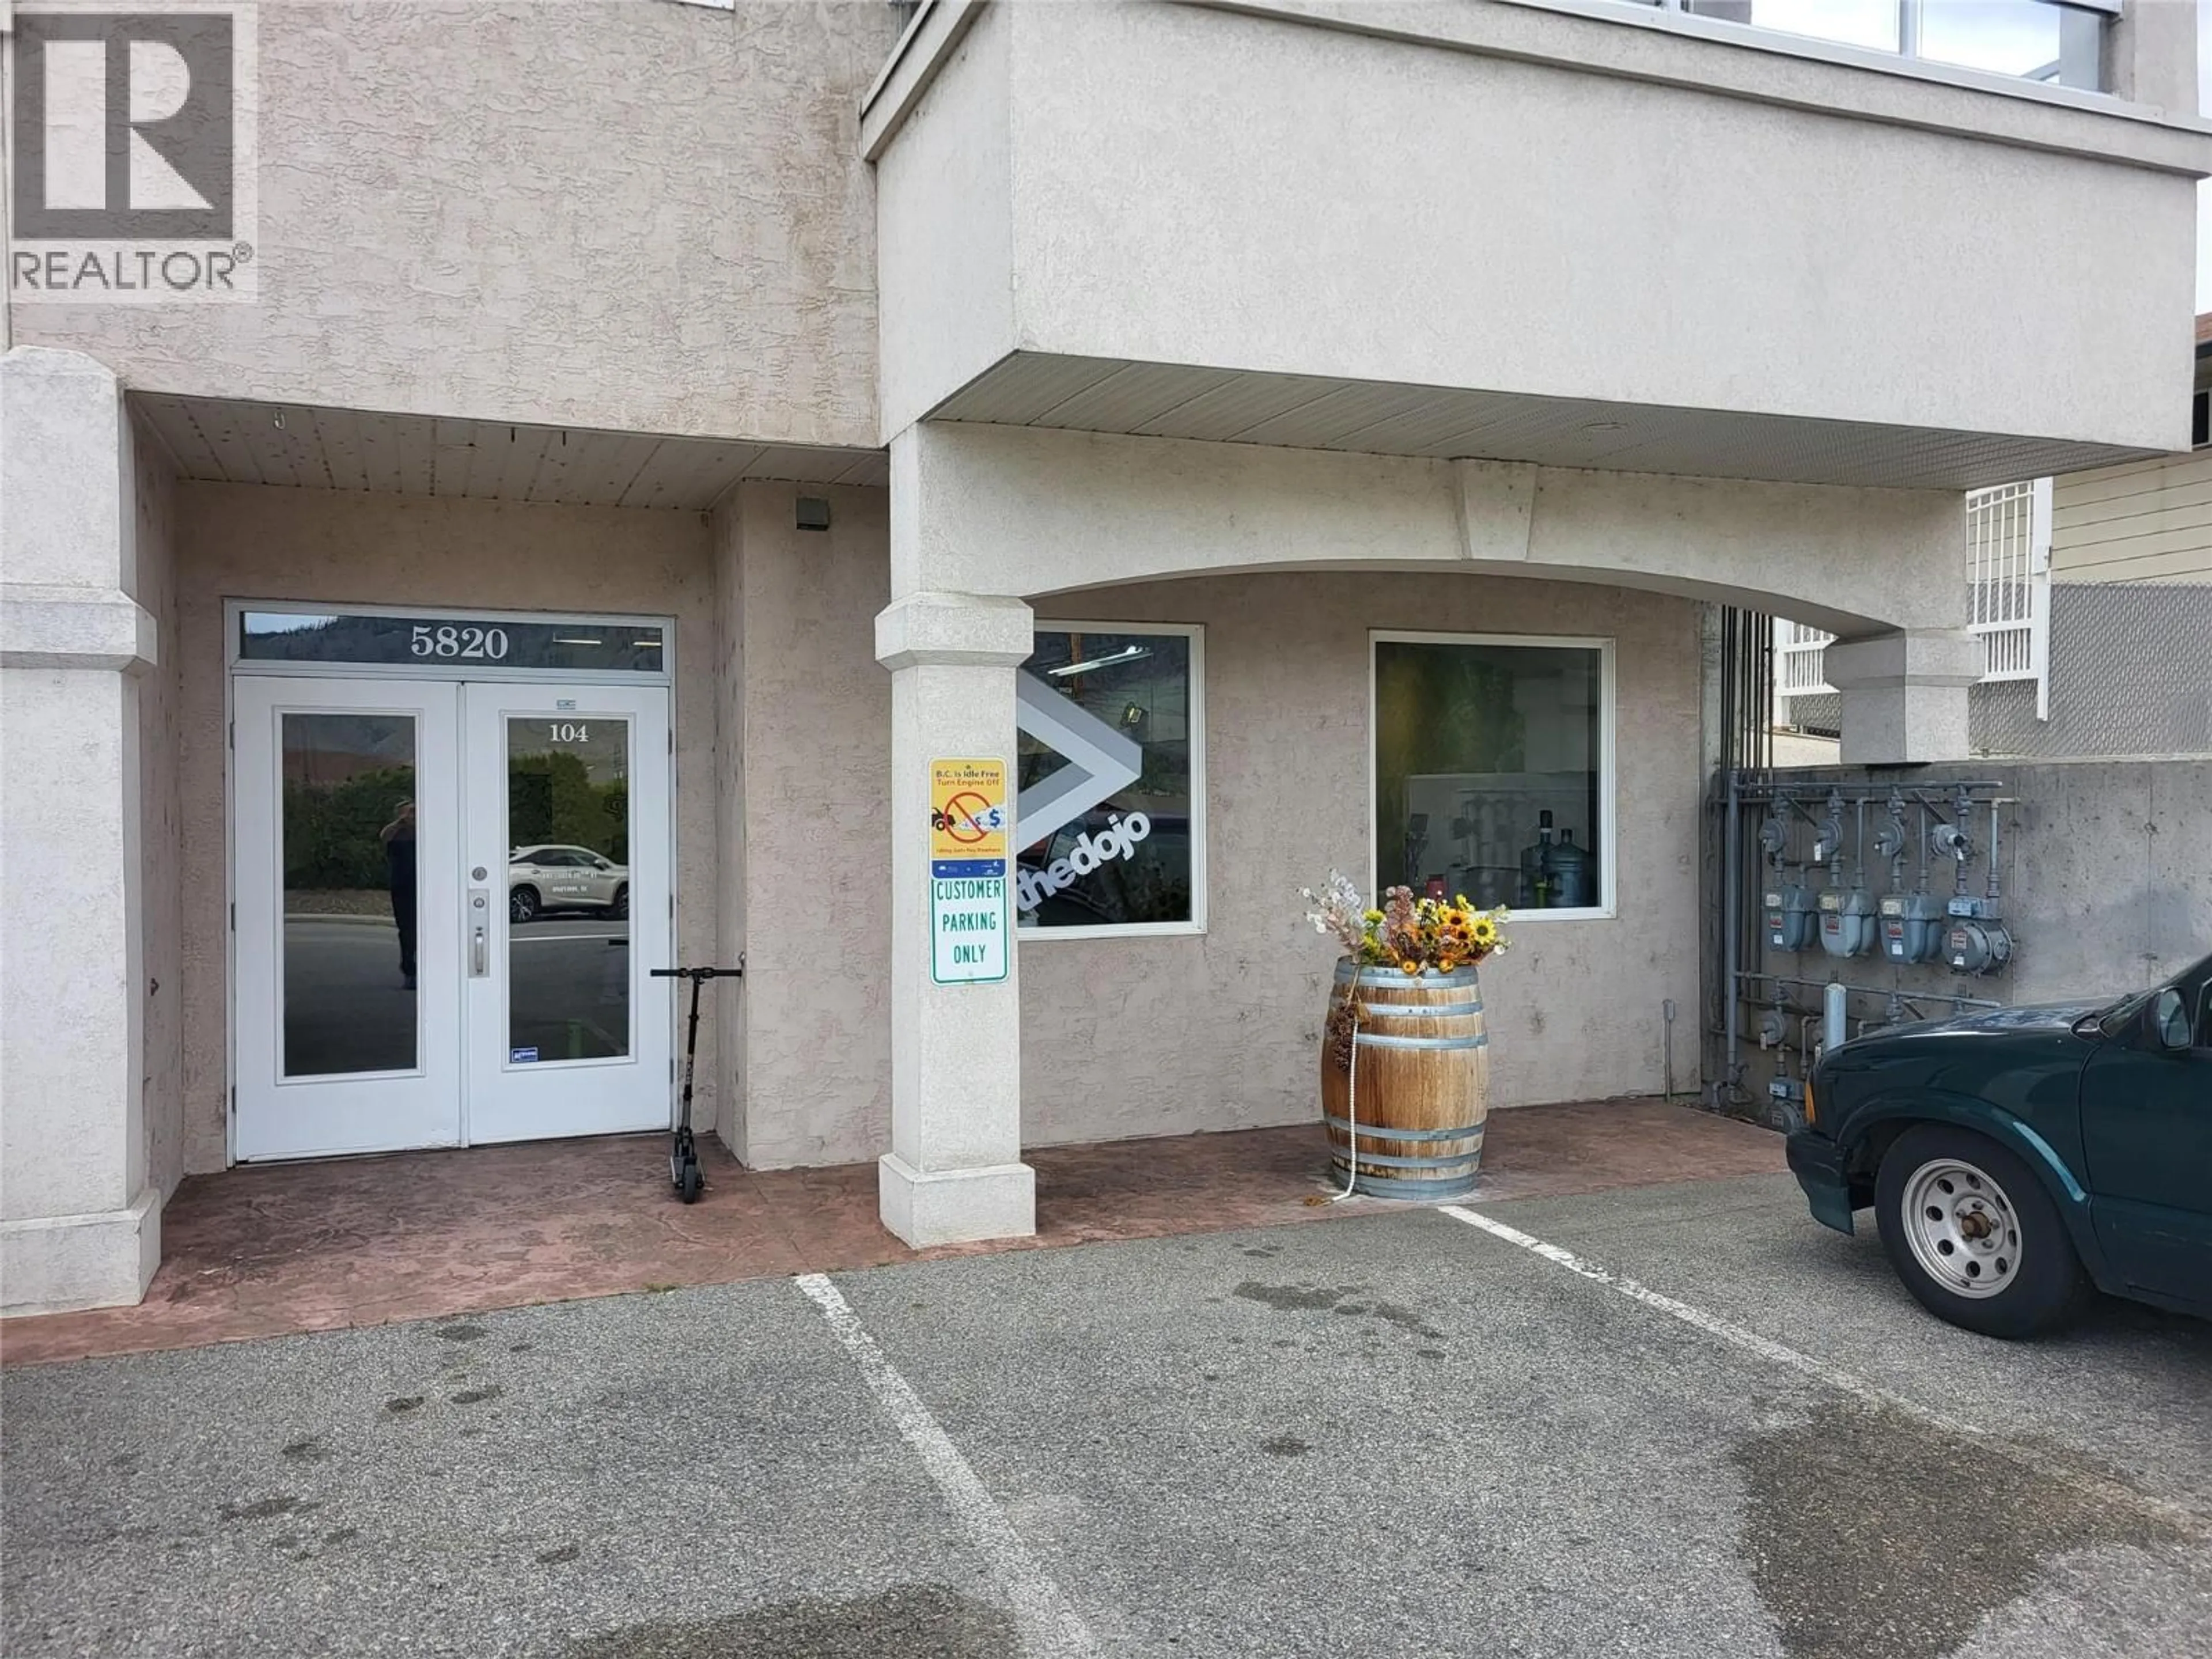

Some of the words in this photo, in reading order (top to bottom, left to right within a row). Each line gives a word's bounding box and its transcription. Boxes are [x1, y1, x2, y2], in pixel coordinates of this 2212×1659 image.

[411, 626, 509, 659] 5820
[550, 723, 589, 743] 104
[957, 779, 984, 787] Engine
[937, 880, 1001, 900] CUSTOMER
[942, 912, 996, 931] PARKING
[954, 944, 986, 963] ONLY
